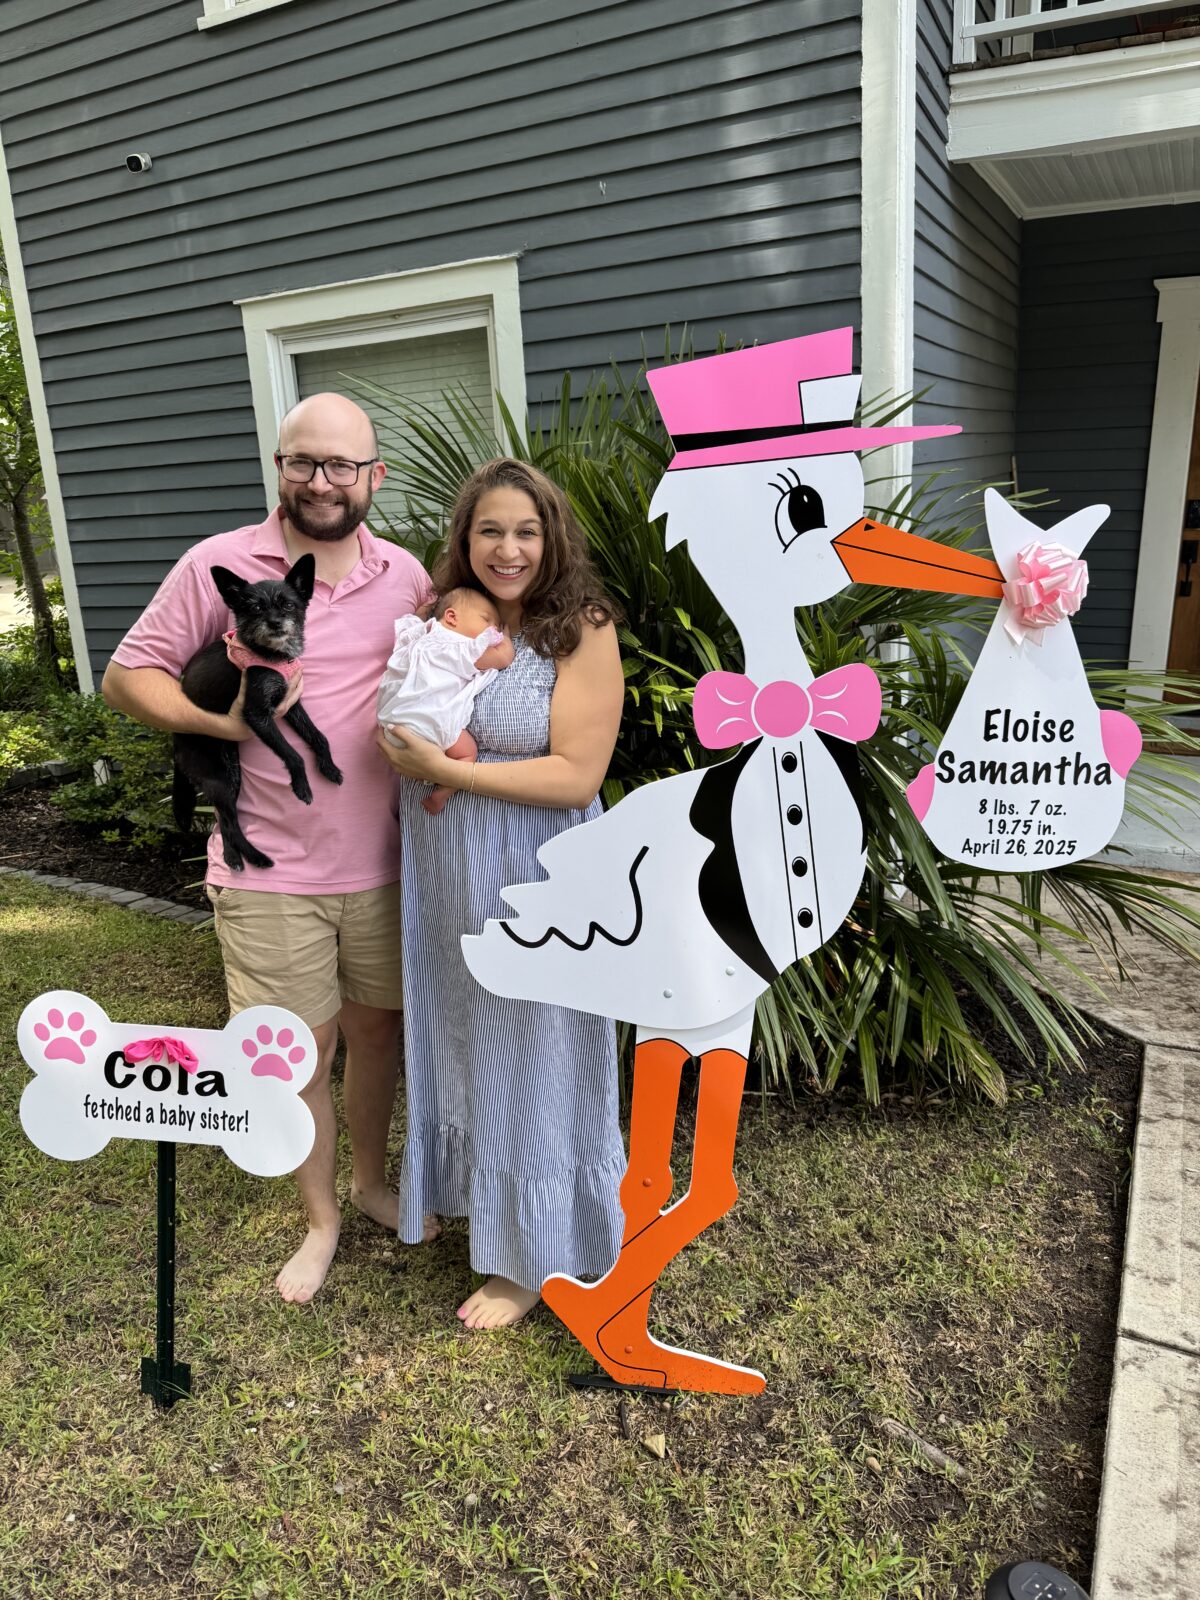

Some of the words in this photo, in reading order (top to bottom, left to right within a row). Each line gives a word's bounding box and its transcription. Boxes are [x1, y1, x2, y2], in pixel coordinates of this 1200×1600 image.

[983, 708, 1075, 743] Eloise
[935, 750, 1112, 786] Samantha
[978, 798, 988, 815] 8
[993, 798, 1019, 816] lbs.
[1029, 799, 1041, 816] 7
[1045, 803, 1067, 816] oz.
[988, 818, 1033, 836] 19.75
[1037, 820, 1056, 836] in.
[961, 838, 1000, 858] April
[1004, 838, 1028, 857] 26,
[1033, 839, 1078, 856] 2025
[103, 1050, 229, 1098] Cola
[83, 1094, 142, 1123] fetched
[145, 1107, 155, 1124] a
[159, 1102, 196, 1132] baby
[200, 1107, 249, 1133] sister!
